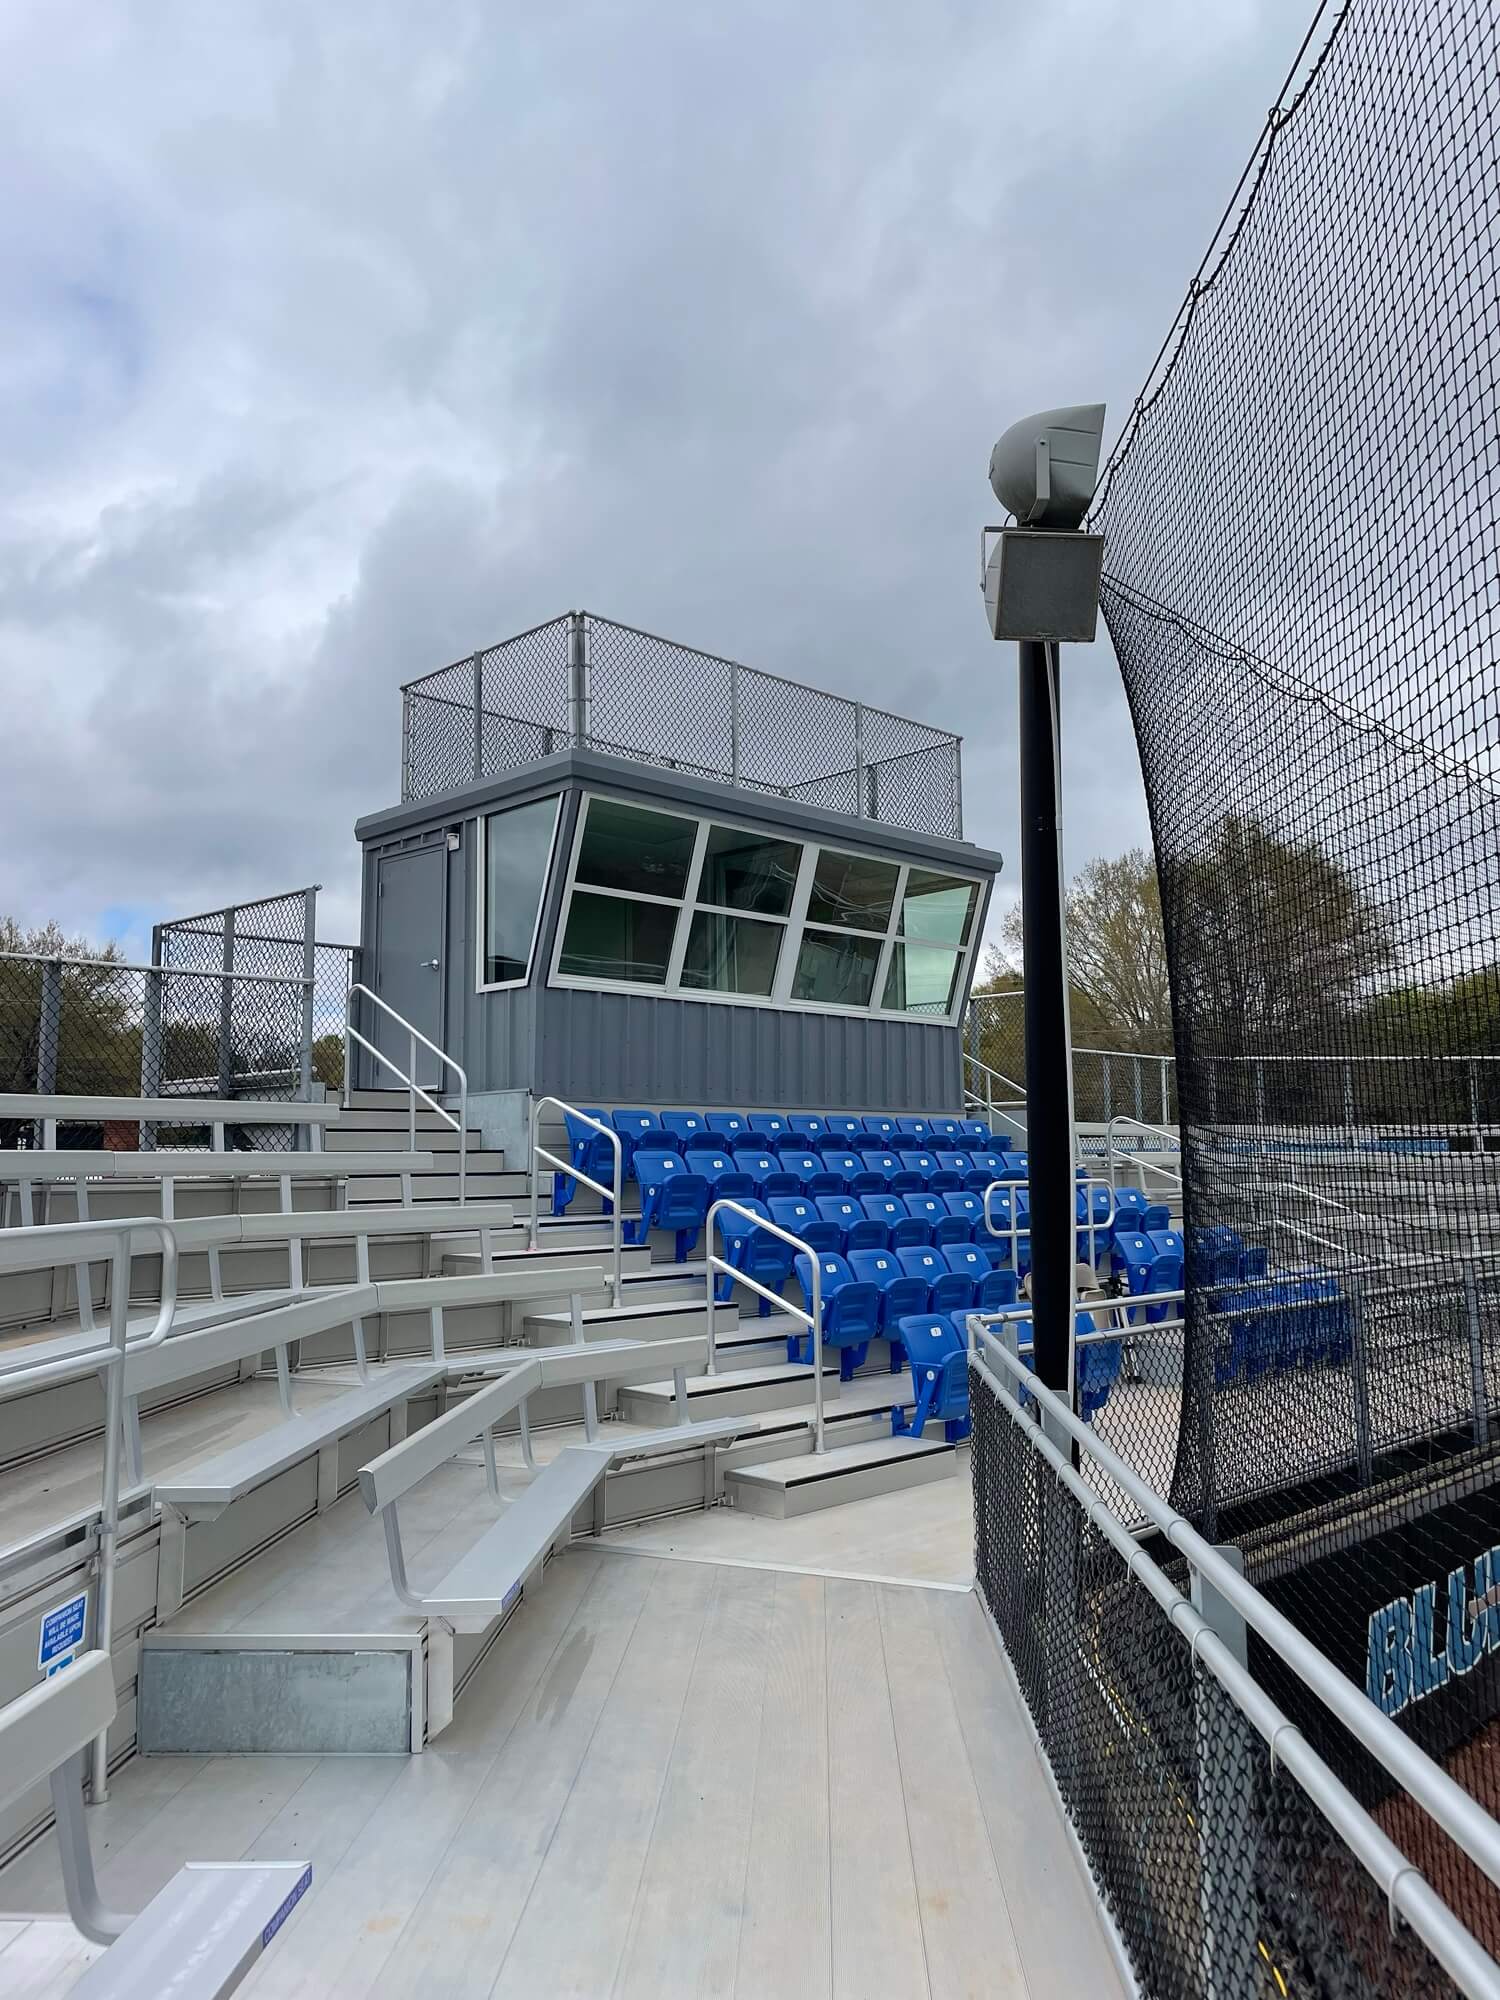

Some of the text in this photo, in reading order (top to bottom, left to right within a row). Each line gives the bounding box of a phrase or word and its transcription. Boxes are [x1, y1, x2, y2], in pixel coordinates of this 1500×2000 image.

[44, 1621, 81, 1648] AVAILABLE UPON
[48, 1612, 80, 1636] WILL BE MADE
